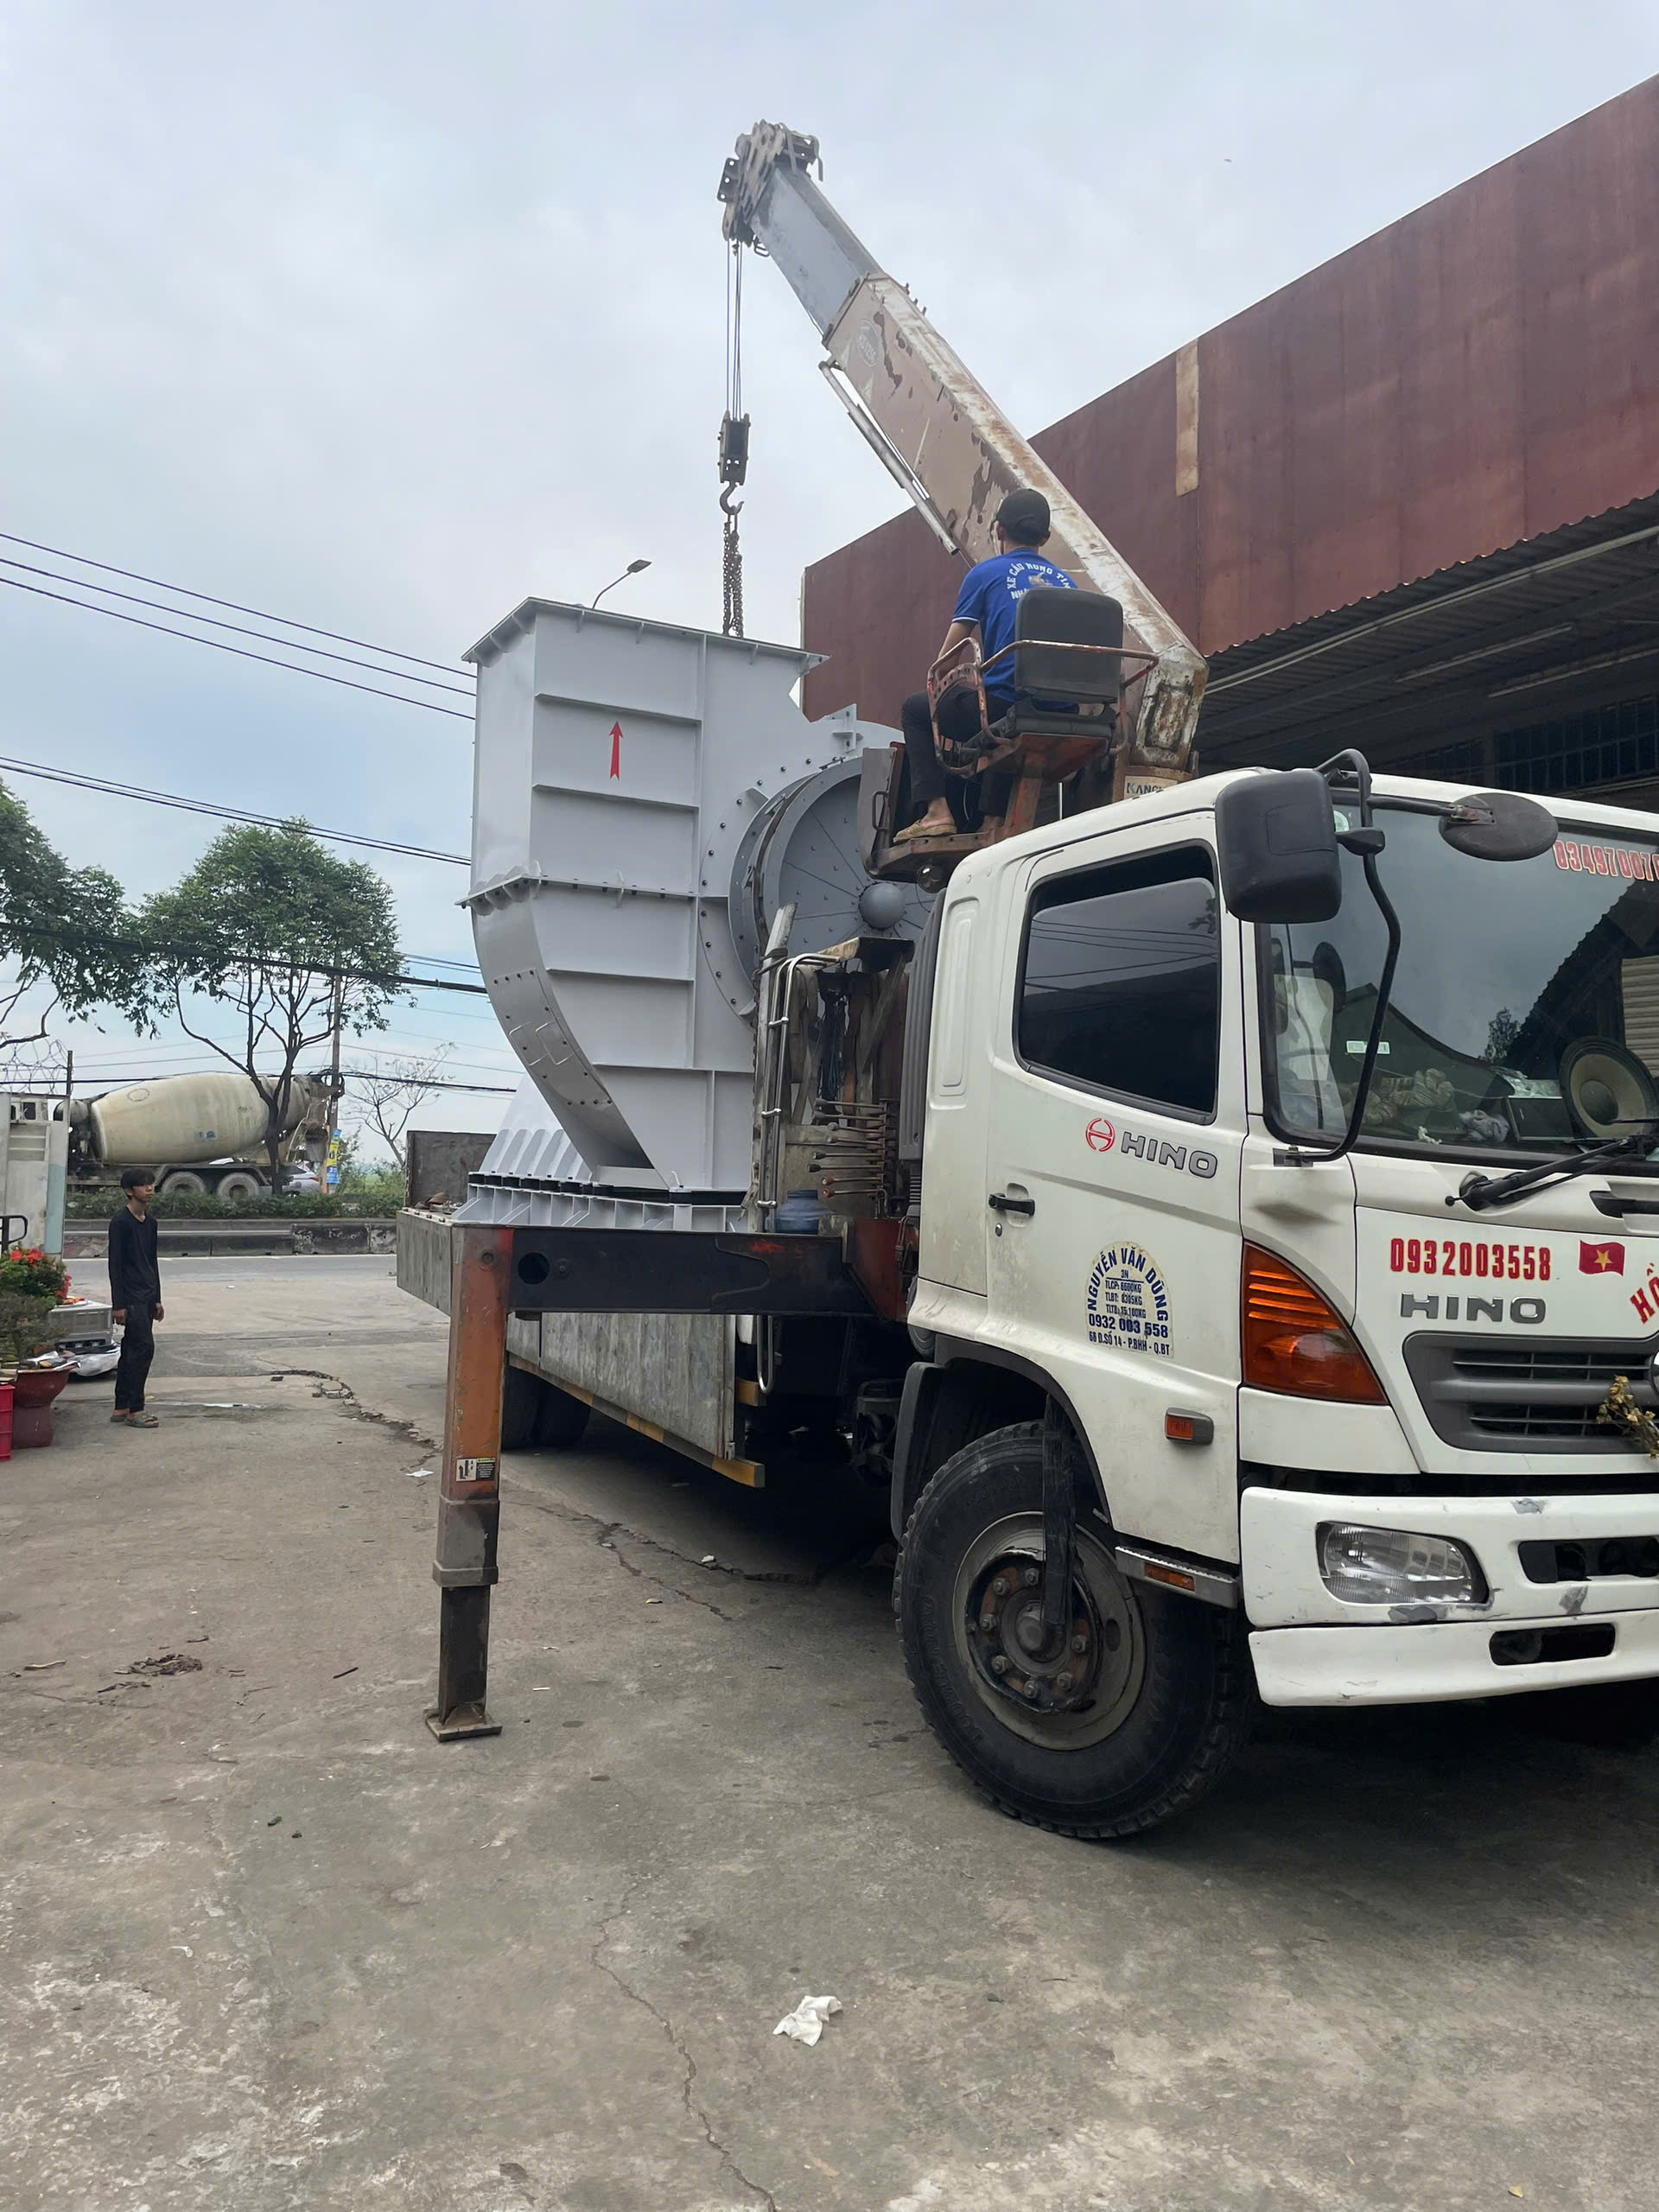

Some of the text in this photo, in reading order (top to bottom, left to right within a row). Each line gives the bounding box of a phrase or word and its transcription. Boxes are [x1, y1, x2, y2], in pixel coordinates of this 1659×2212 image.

[1121, 1131, 1217, 1179] HINO
[1121, 1246, 1146, 1272] VĂN
[1390, 1237, 1550, 1281] 0932003558
[1401, 1292, 1546, 1324] HINO
[1089, 1313, 1168, 1338] 0932 003 558
[1154, 1342, 1170, 1355] Q.BT
